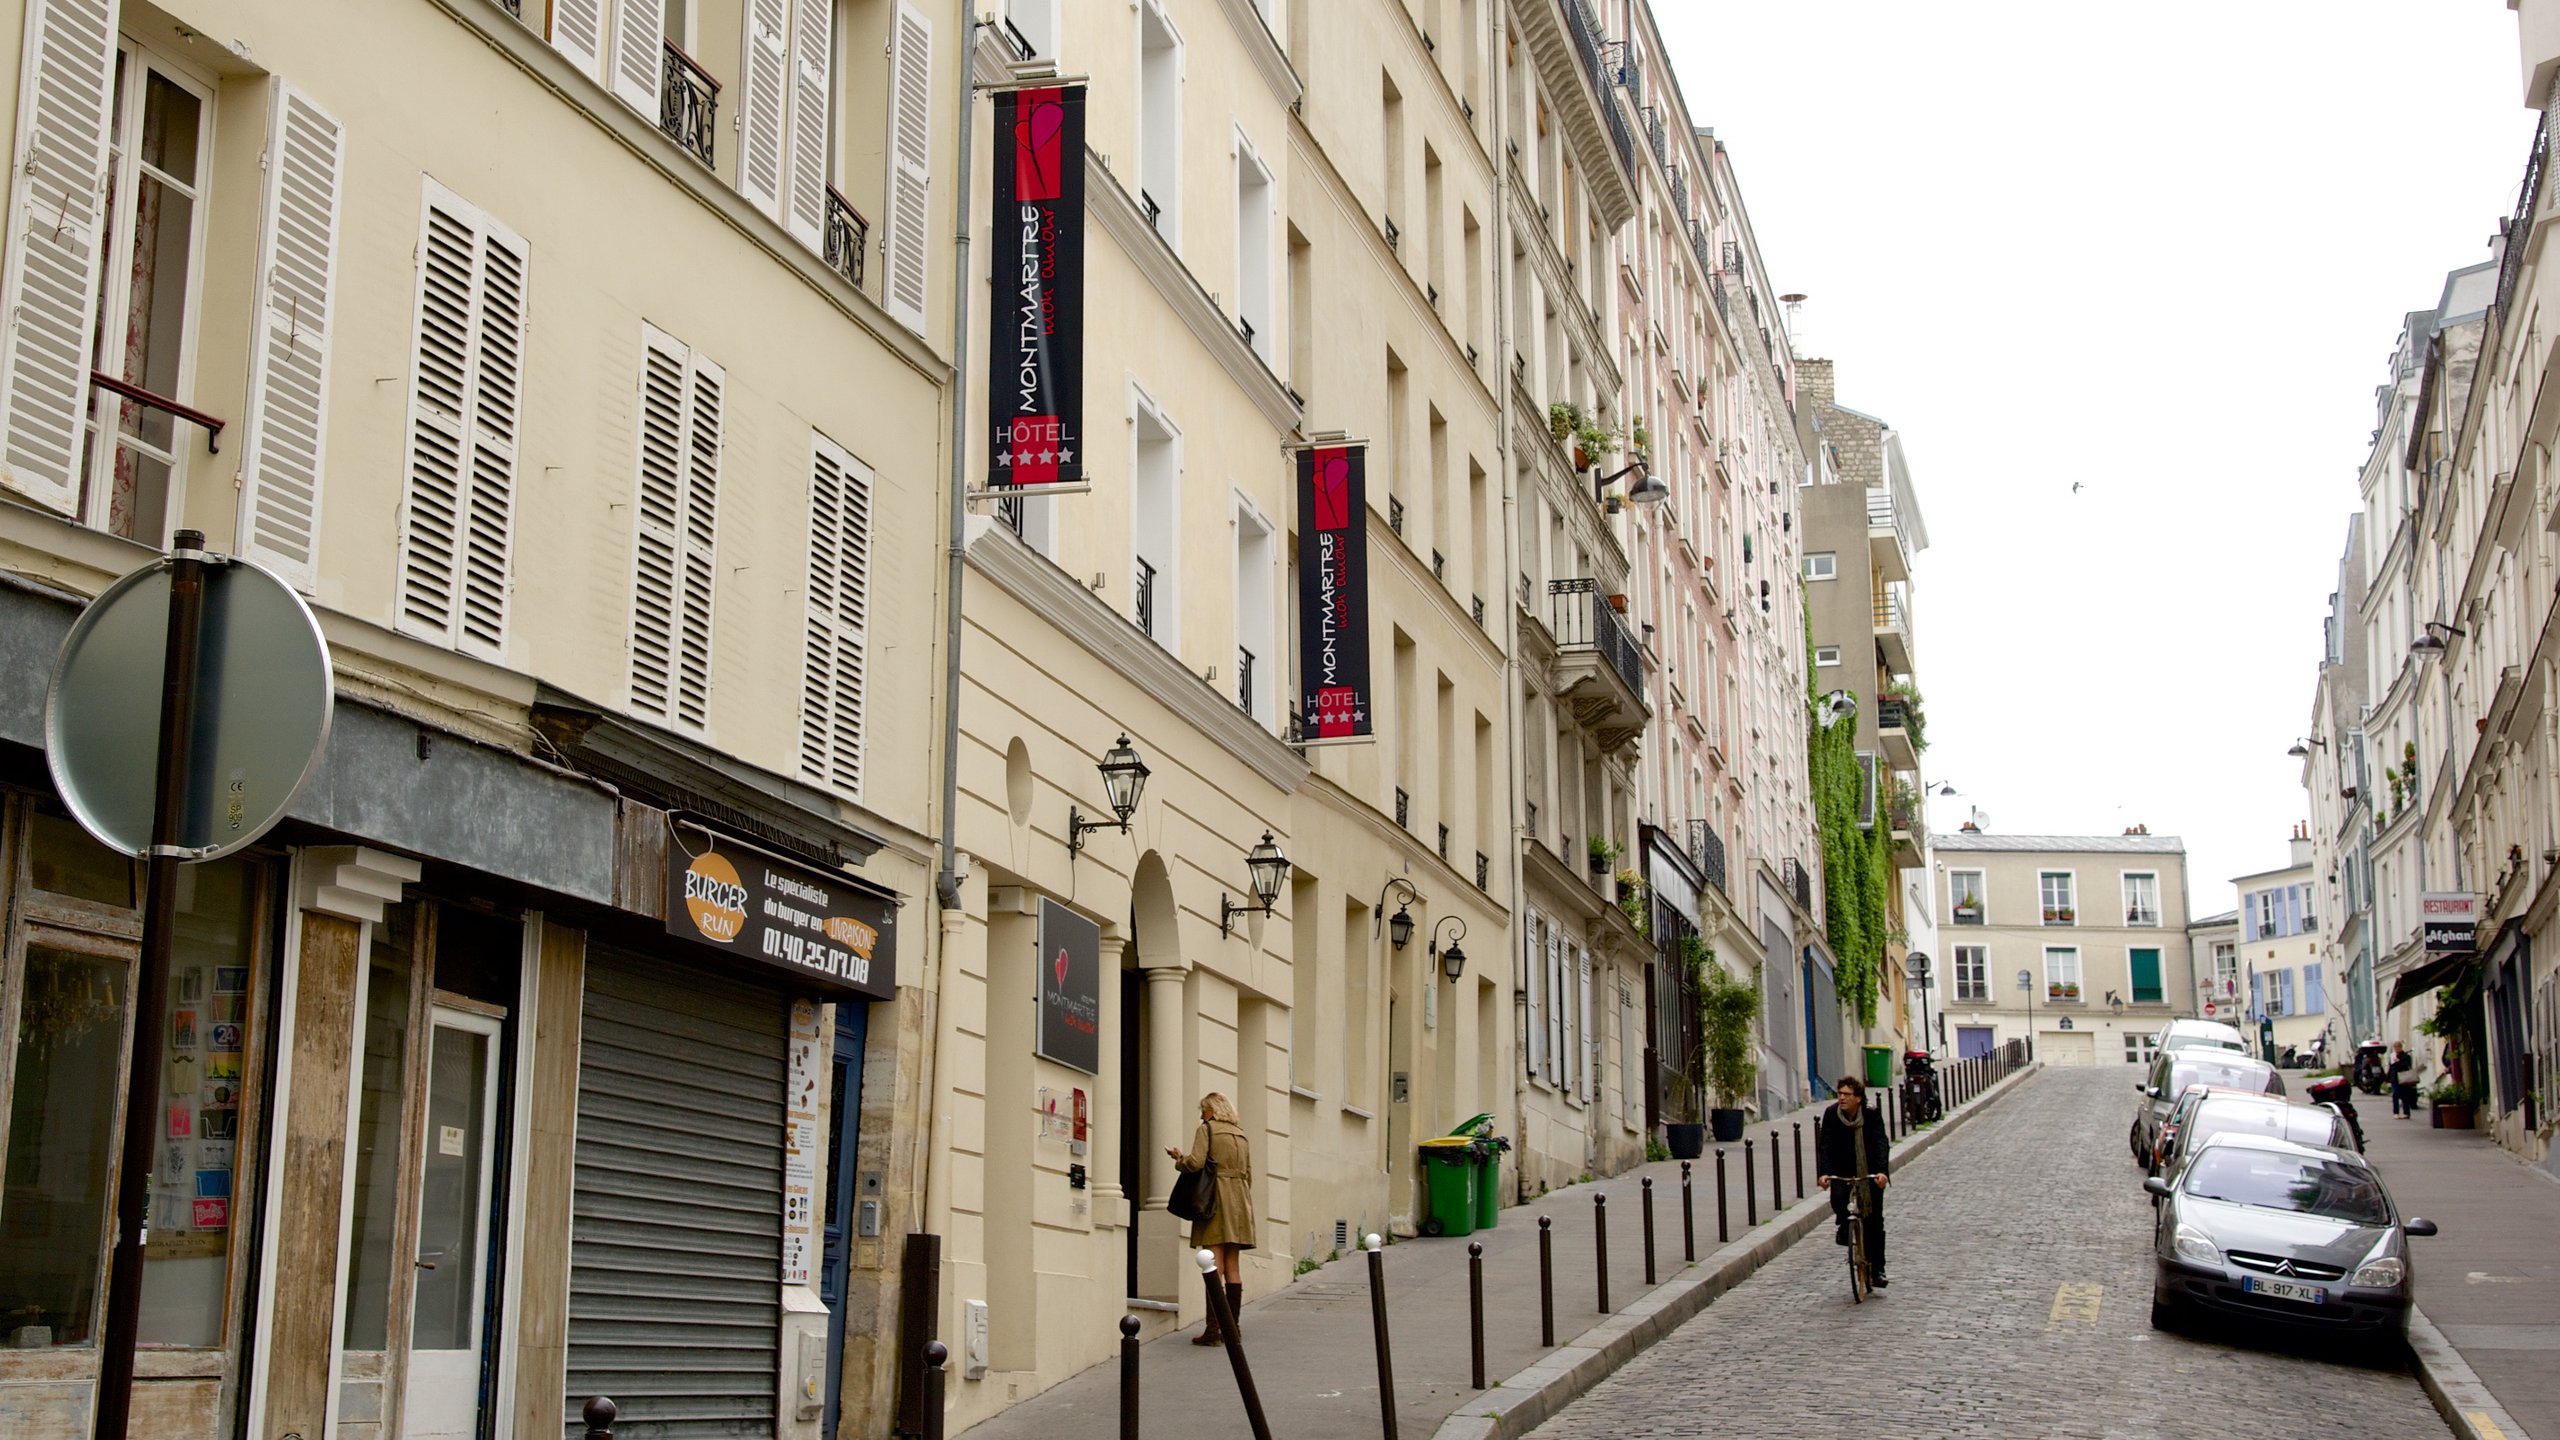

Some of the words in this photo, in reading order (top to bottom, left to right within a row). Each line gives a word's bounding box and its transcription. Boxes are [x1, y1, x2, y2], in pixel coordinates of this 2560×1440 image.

[1041, 206, 1055, 279] amour
[1020, 205, 1039, 413] MONTMARTRE
[1041, 288, 1055, 335] mon
[996, 421, 1075, 444] HÔTEL
[1320, 533, 1336, 685] MONTMARTRE
[1307, 691, 1365, 708] HÔTEL
[685, 869, 748, 918] BURGER
[764, 869, 777, 888] Le
[777, 877, 829, 907] spécialiste
[2423, 899, 2473, 914] RESTAURANT
[702, 912, 734, 937] RUN
[763, 898, 777, 917] du
[777, 901, 811, 928] burger
[810, 916, 823, 932] en
[763, 927, 870, 985] 01.40.25.07.08
